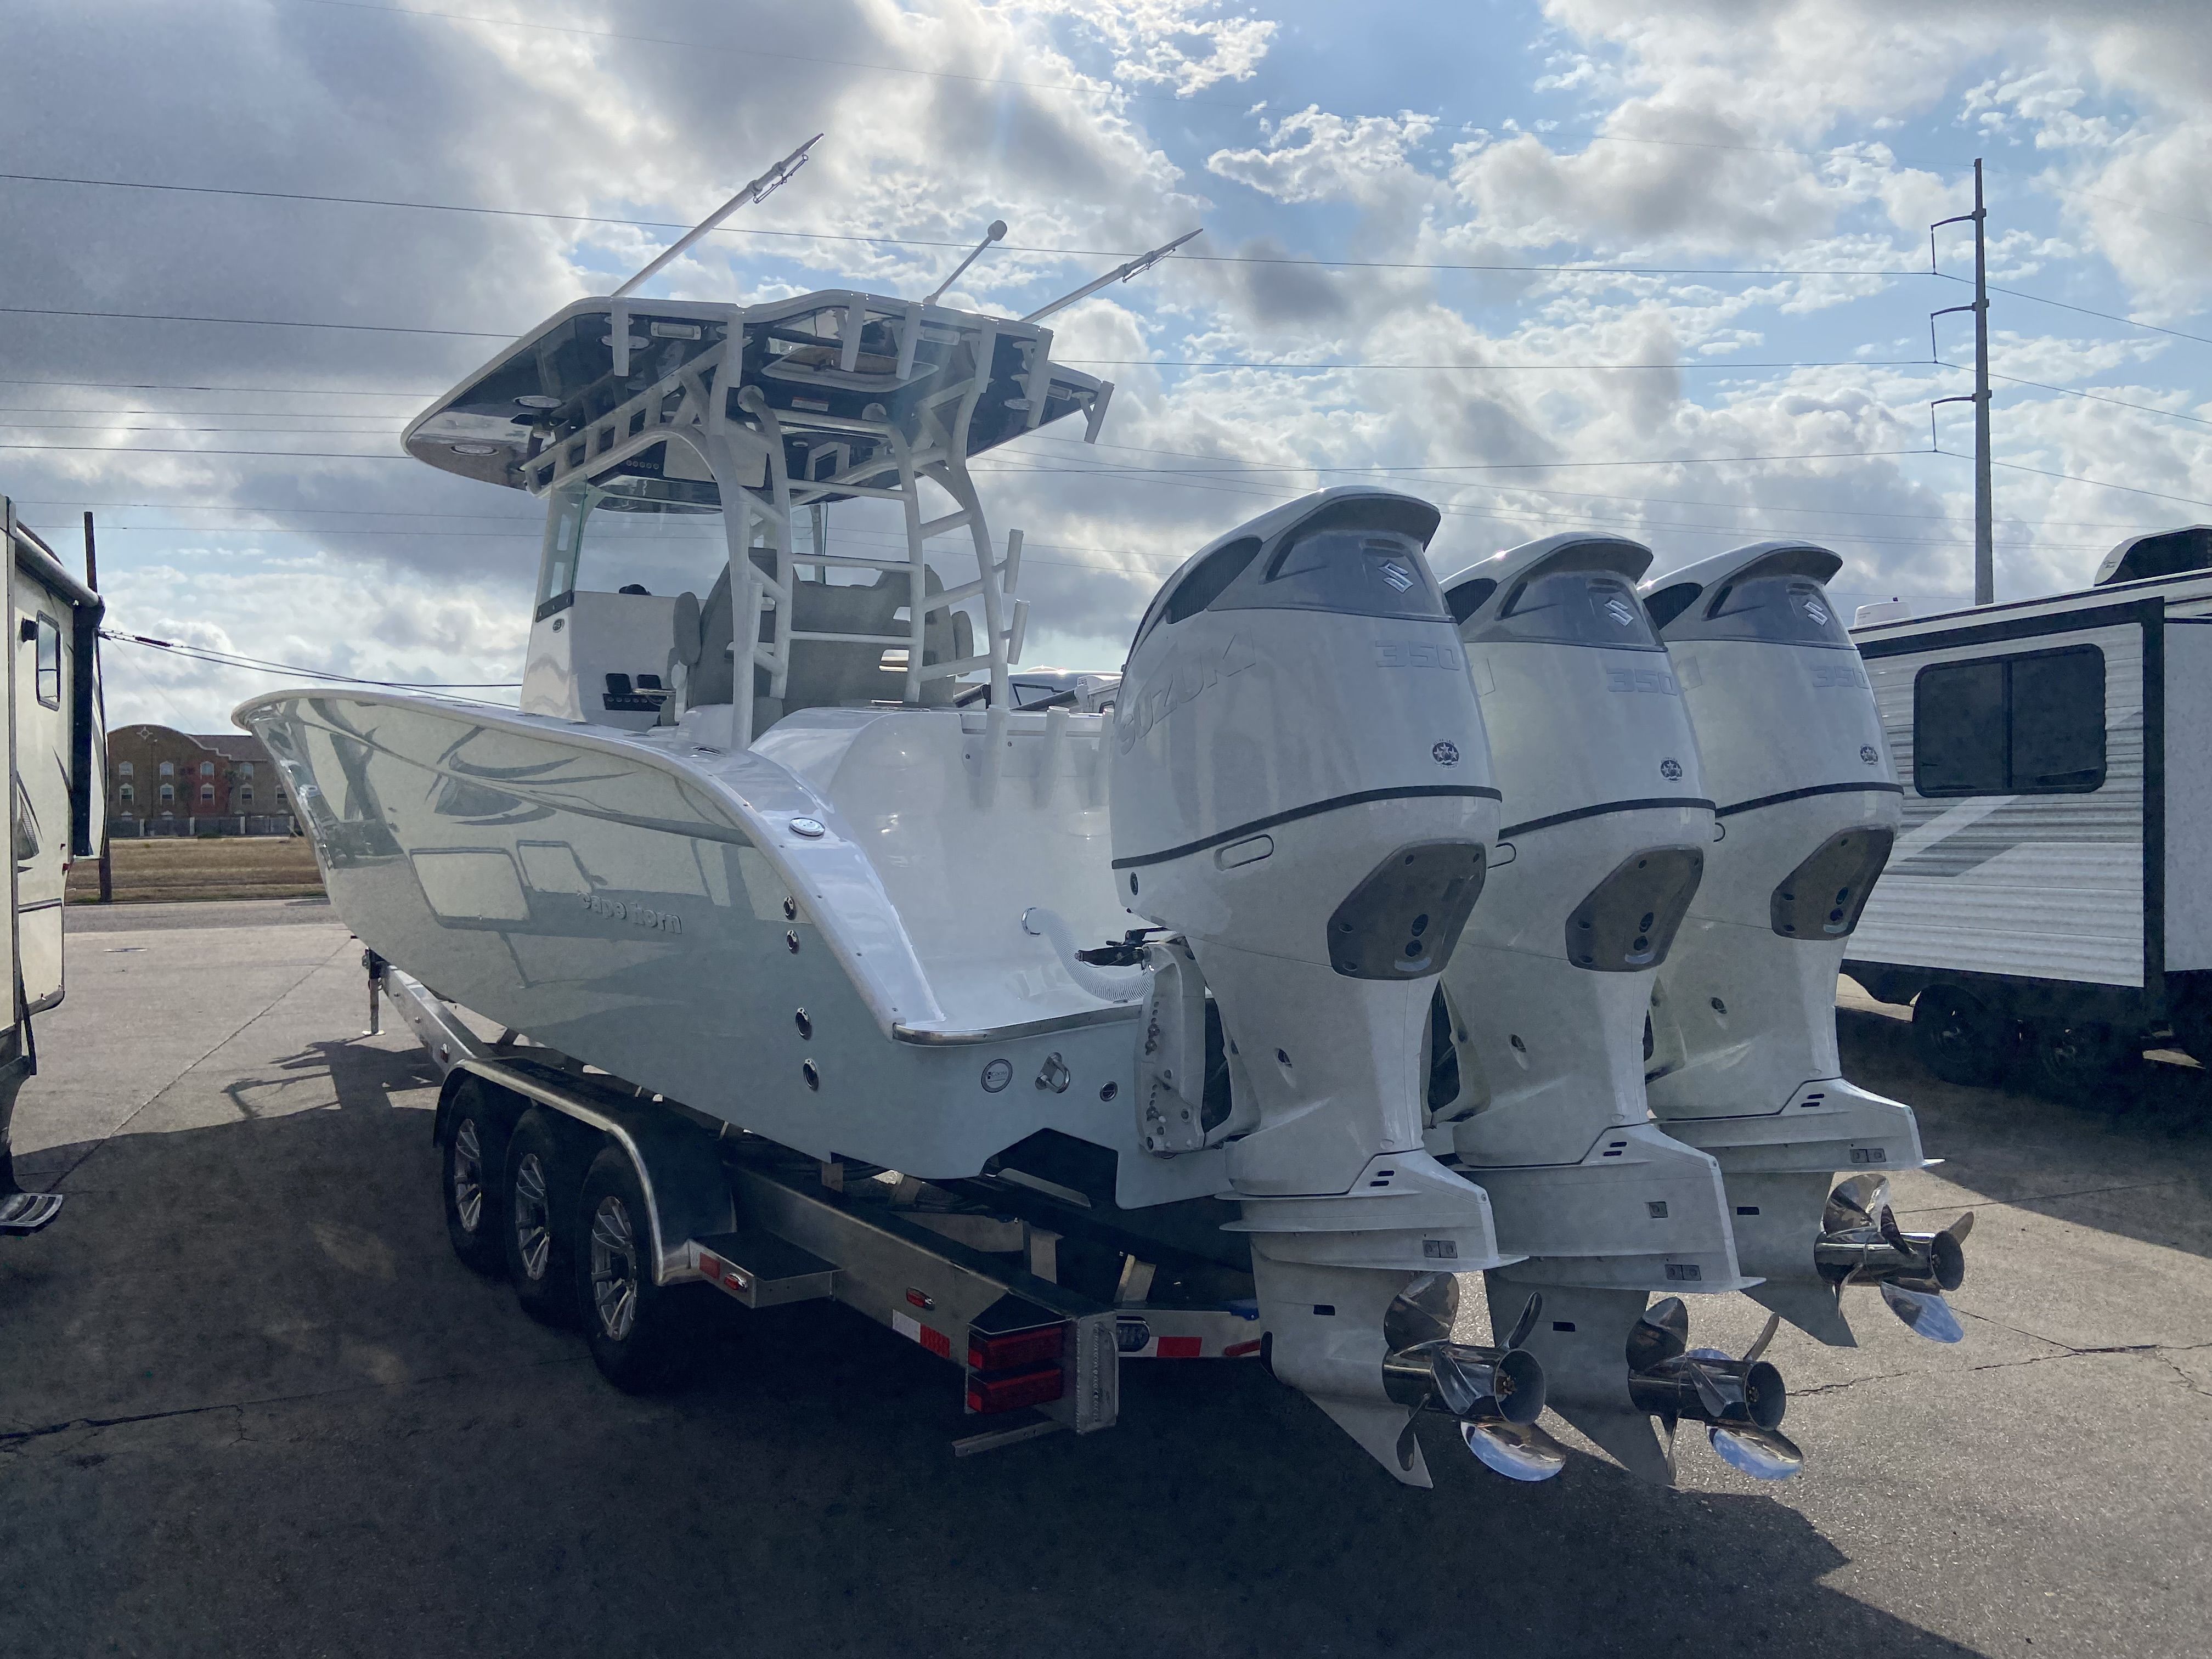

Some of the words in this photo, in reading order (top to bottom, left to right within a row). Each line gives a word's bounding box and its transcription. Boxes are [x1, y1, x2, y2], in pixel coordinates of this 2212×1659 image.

[1375, 640, 1462, 671] 350
[1606, 668, 1678, 696] 350
[1812, 666, 1869, 690] 350
